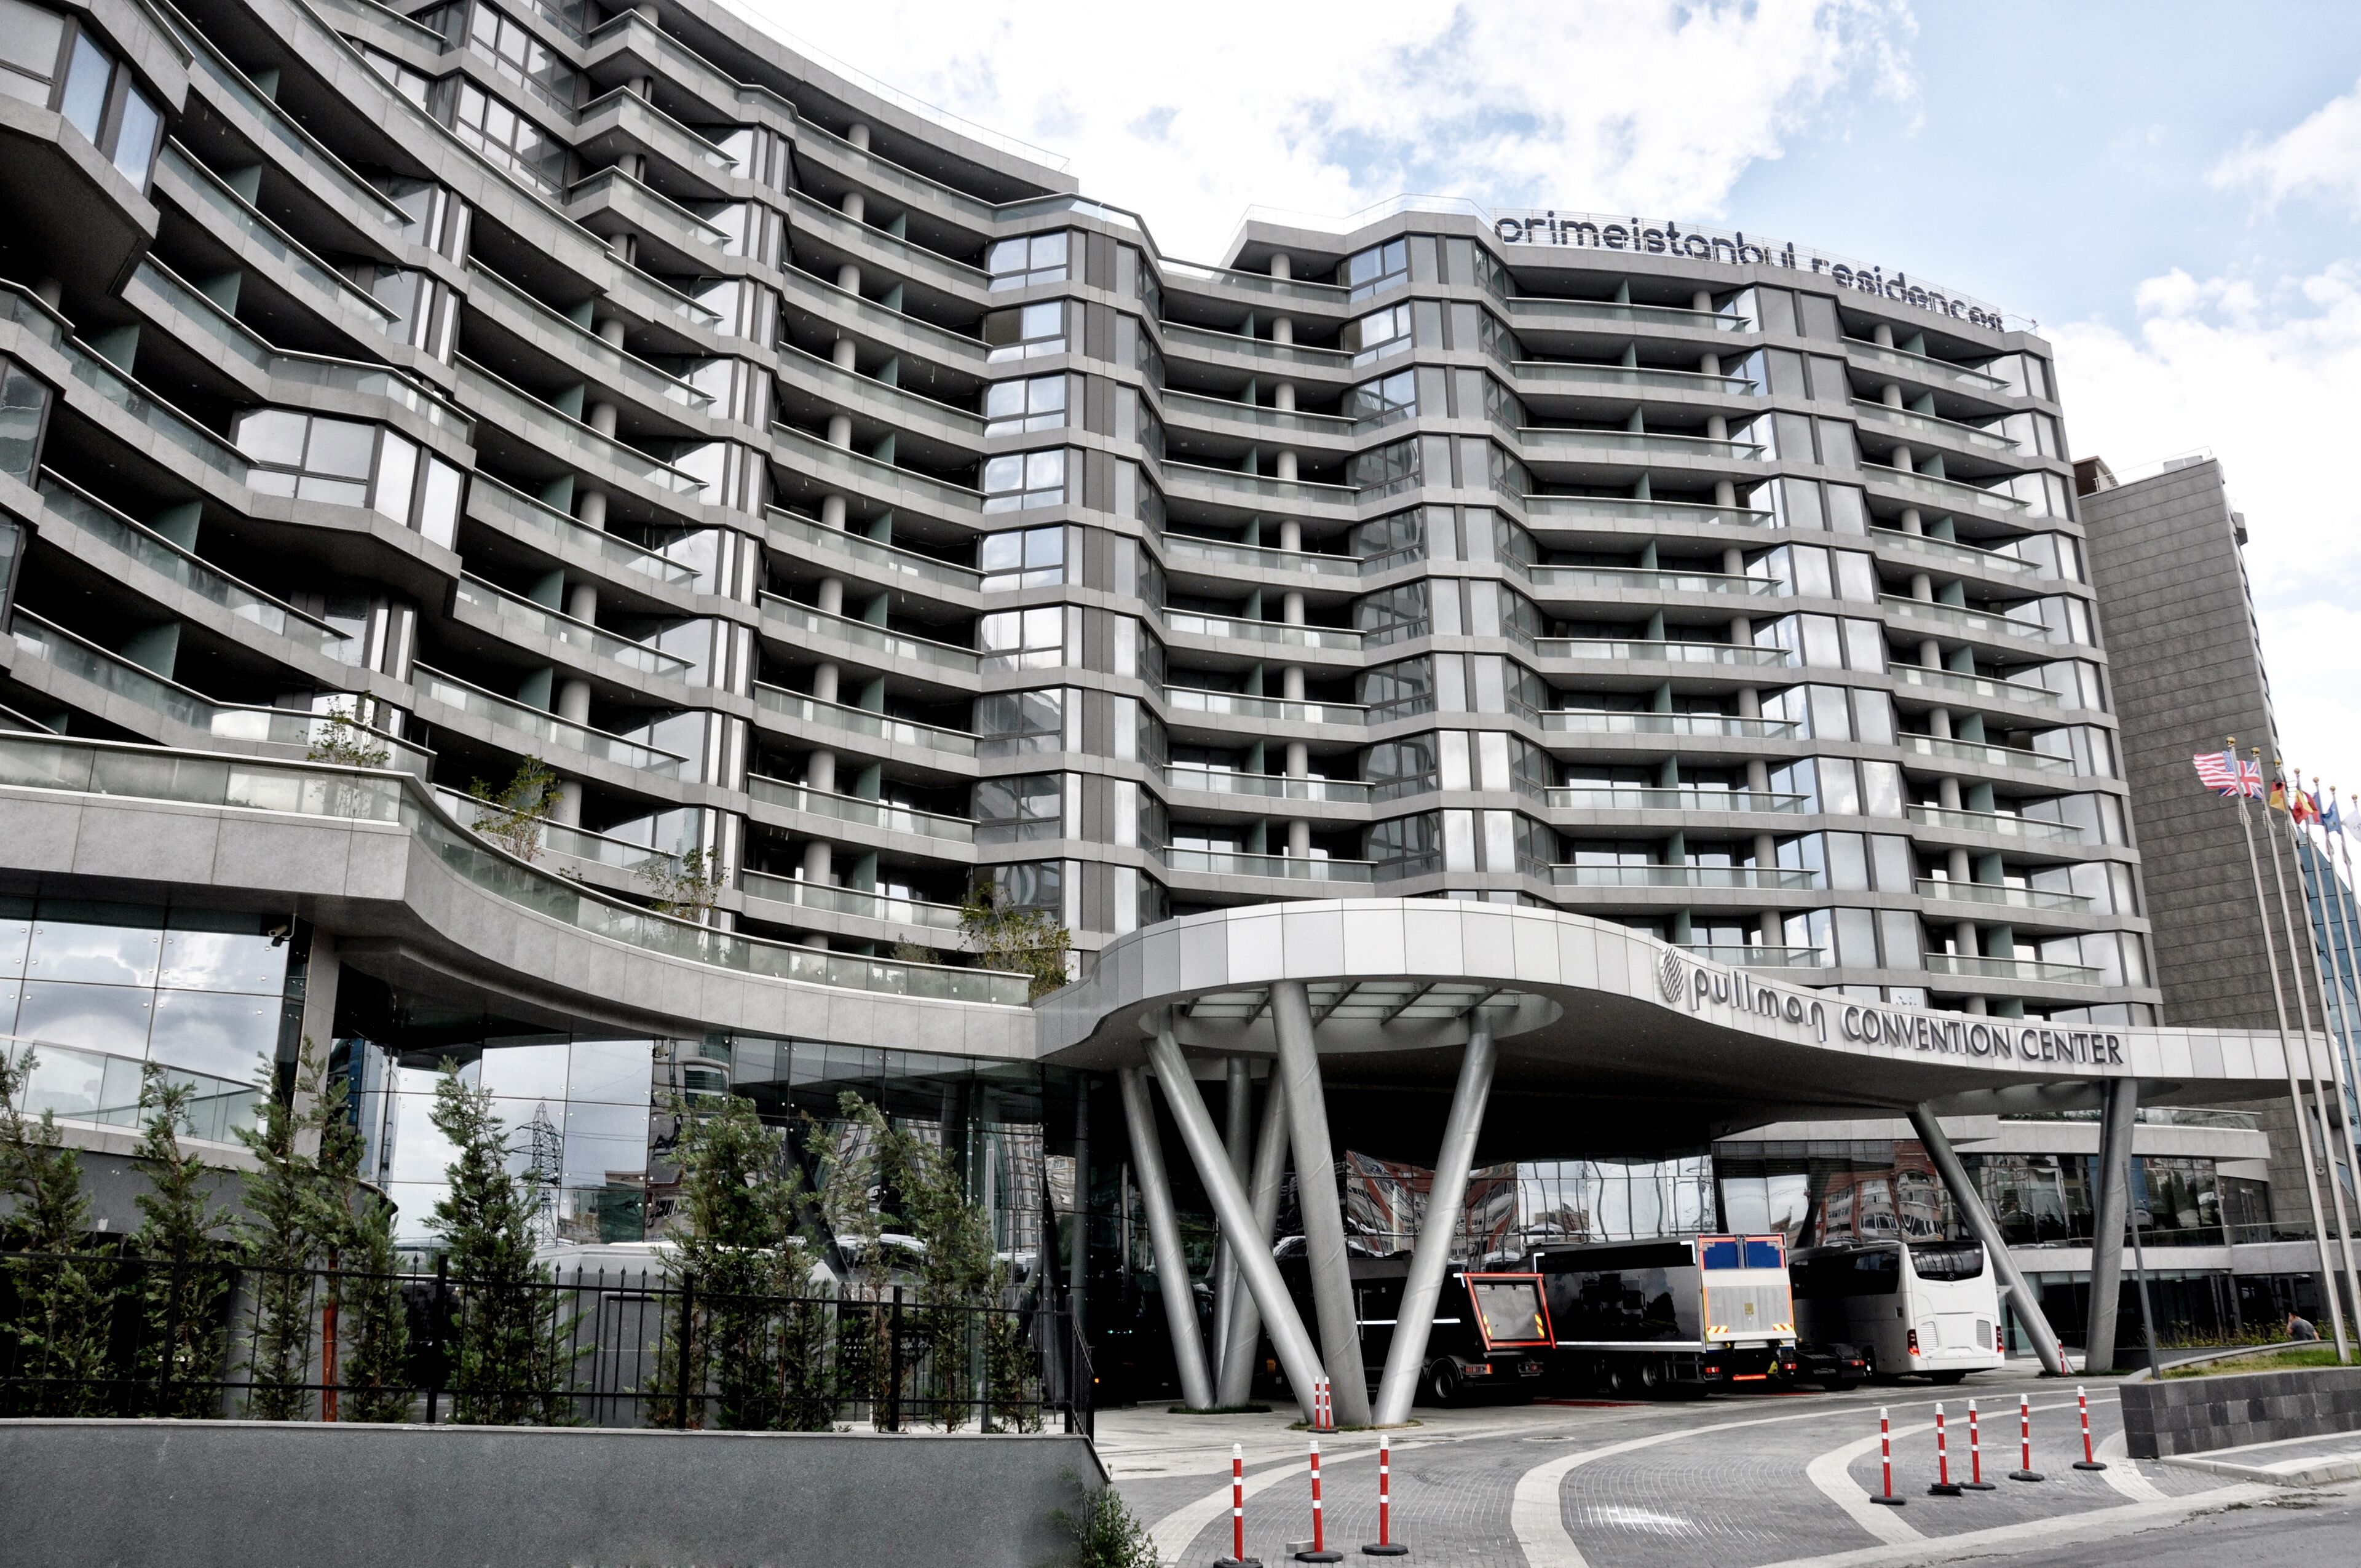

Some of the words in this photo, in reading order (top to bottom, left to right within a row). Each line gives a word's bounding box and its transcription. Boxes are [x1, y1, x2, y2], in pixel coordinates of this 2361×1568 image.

[1811, 257, 2005, 333] residences
[1690, 968, 1827, 1042] pullman
[1841, 1006, 2012, 1059] CONVENTION
[2017, 1029, 2124, 1064] CENTER
